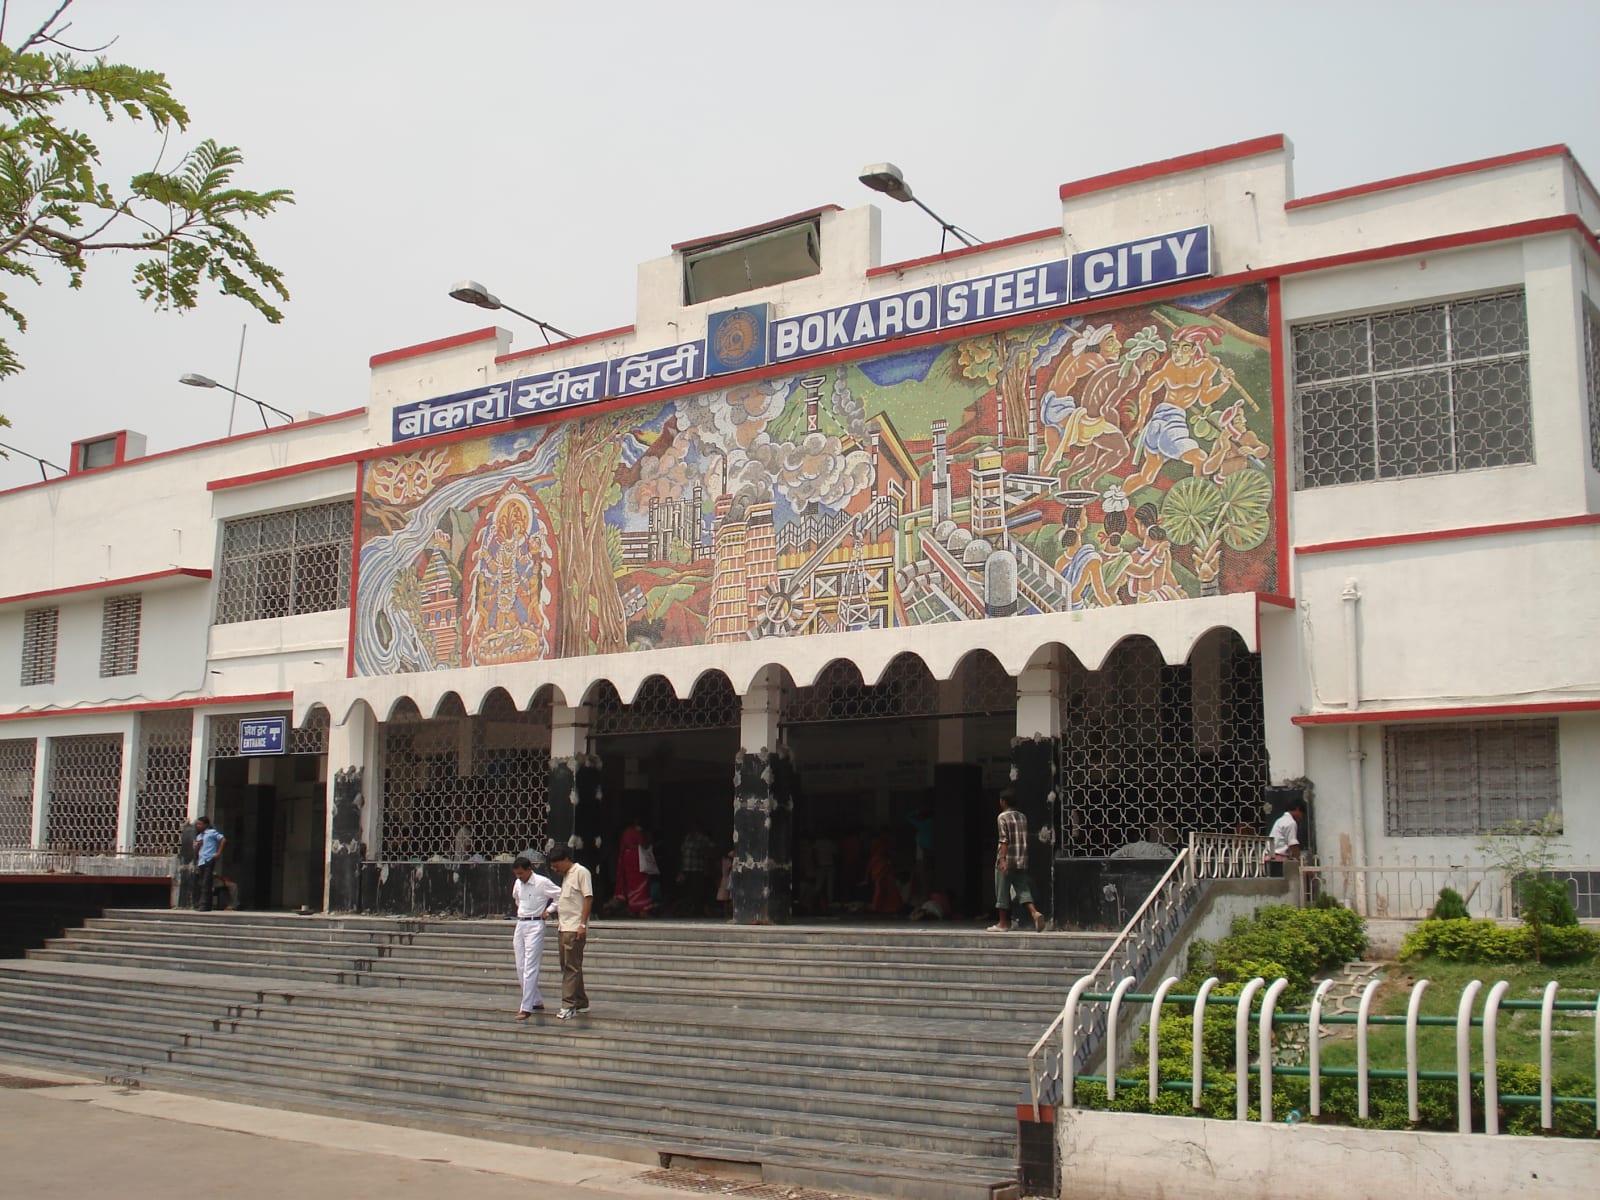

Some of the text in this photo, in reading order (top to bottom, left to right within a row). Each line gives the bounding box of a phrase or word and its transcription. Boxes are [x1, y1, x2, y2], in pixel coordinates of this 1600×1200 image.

[776, 291, 931, 359] BOKARO
[947, 267, 1058, 322] STEEL
[1084, 232, 1197, 293] CITY
[398, 344, 699, 435] बोकारो स्टील सिटी
[243, 737, 266, 748] ENTRANCE
